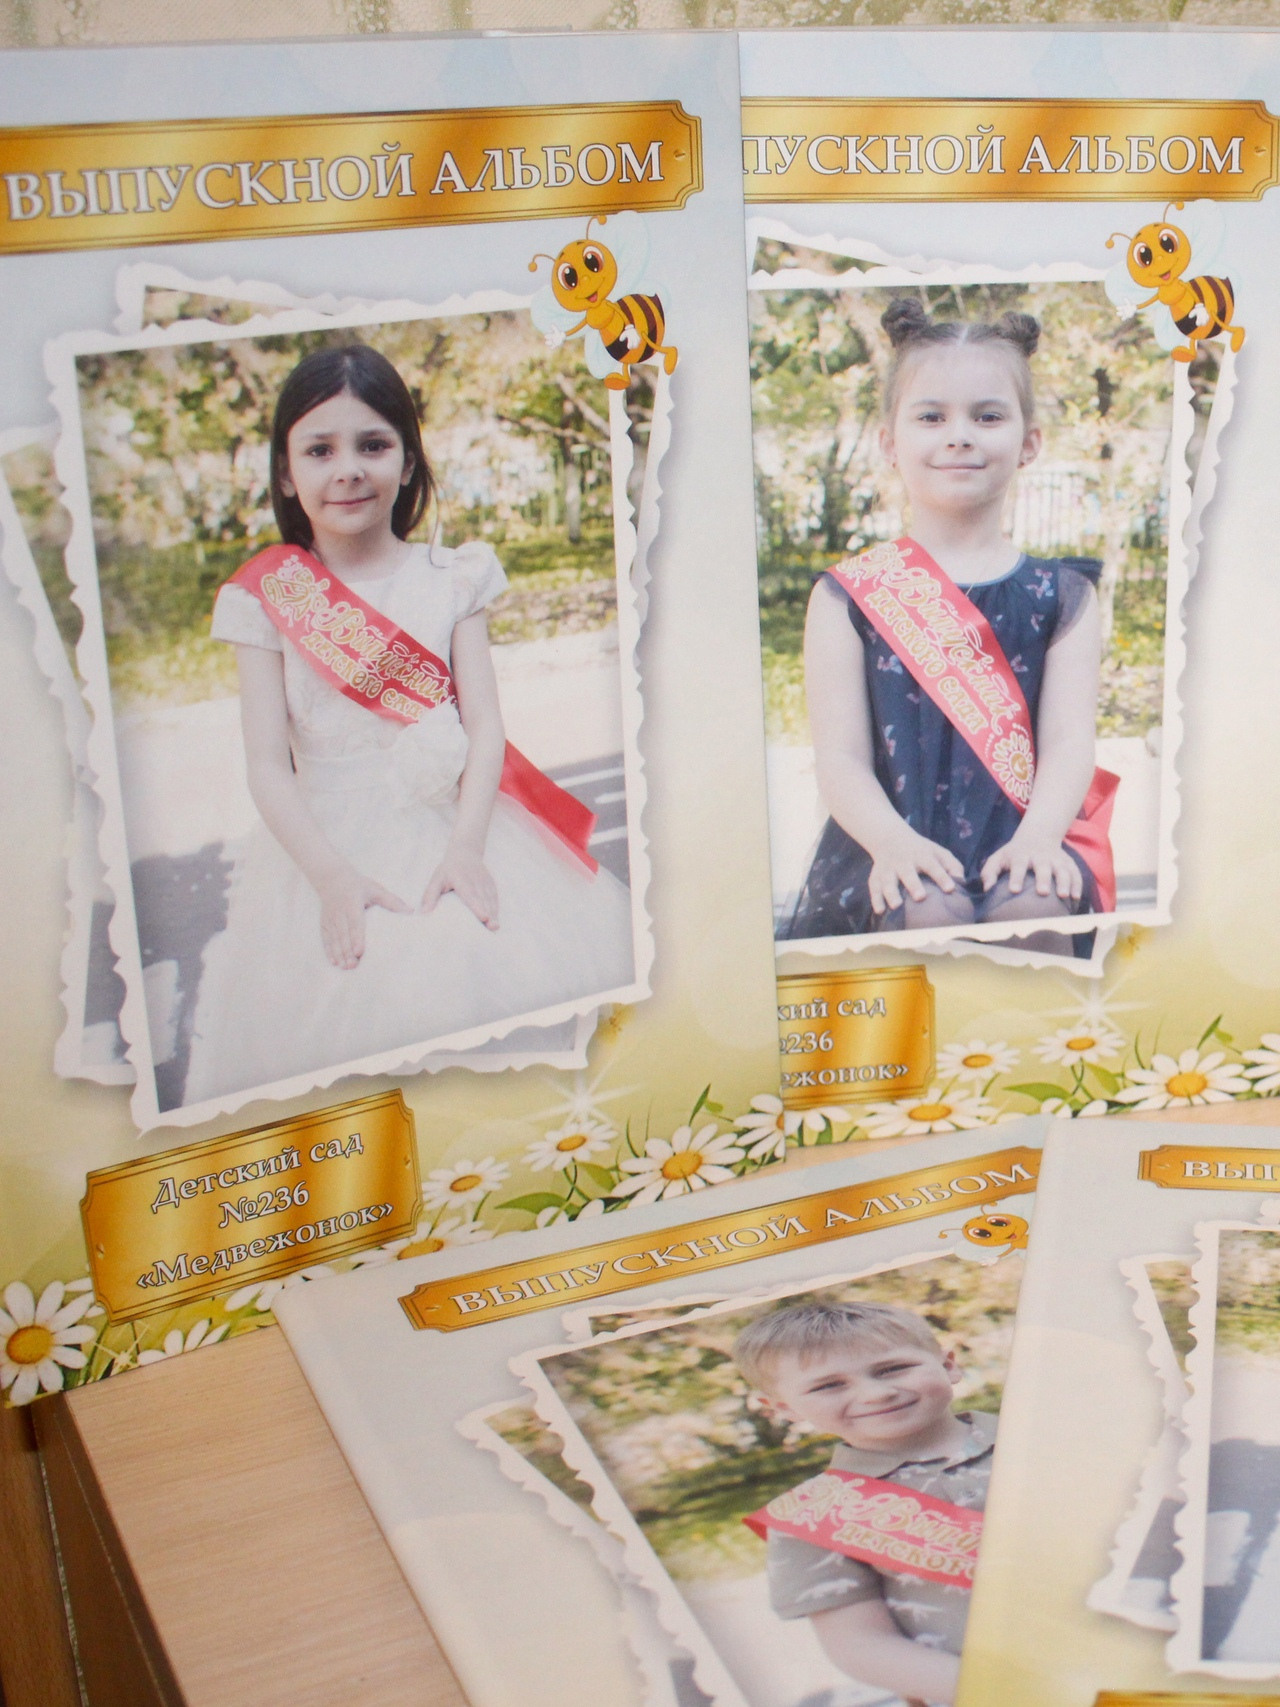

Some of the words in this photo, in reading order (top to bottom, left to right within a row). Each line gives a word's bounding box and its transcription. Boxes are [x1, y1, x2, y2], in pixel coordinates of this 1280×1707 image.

[3, 141, 415, 222] ВЫПУСКНОЙ
[430, 140, 665, 195] АЛЬБОМ
[1018, 134, 1244, 175] АЛЬБОМ
[837, 996, 886, 1018] сад
[779, 1030, 834, 1056] 236
[150, 1146, 302, 1213] Детский
[309, 1132, 365, 1161] сад
[218, 1181, 311, 1228] №236
[136, 1202, 395, 1289] «Медвежонок»
[449, 1213, 812, 1315] ВЫПУСКНОЙ
[823, 1162, 1037, 1229] АЛЬБОМ
